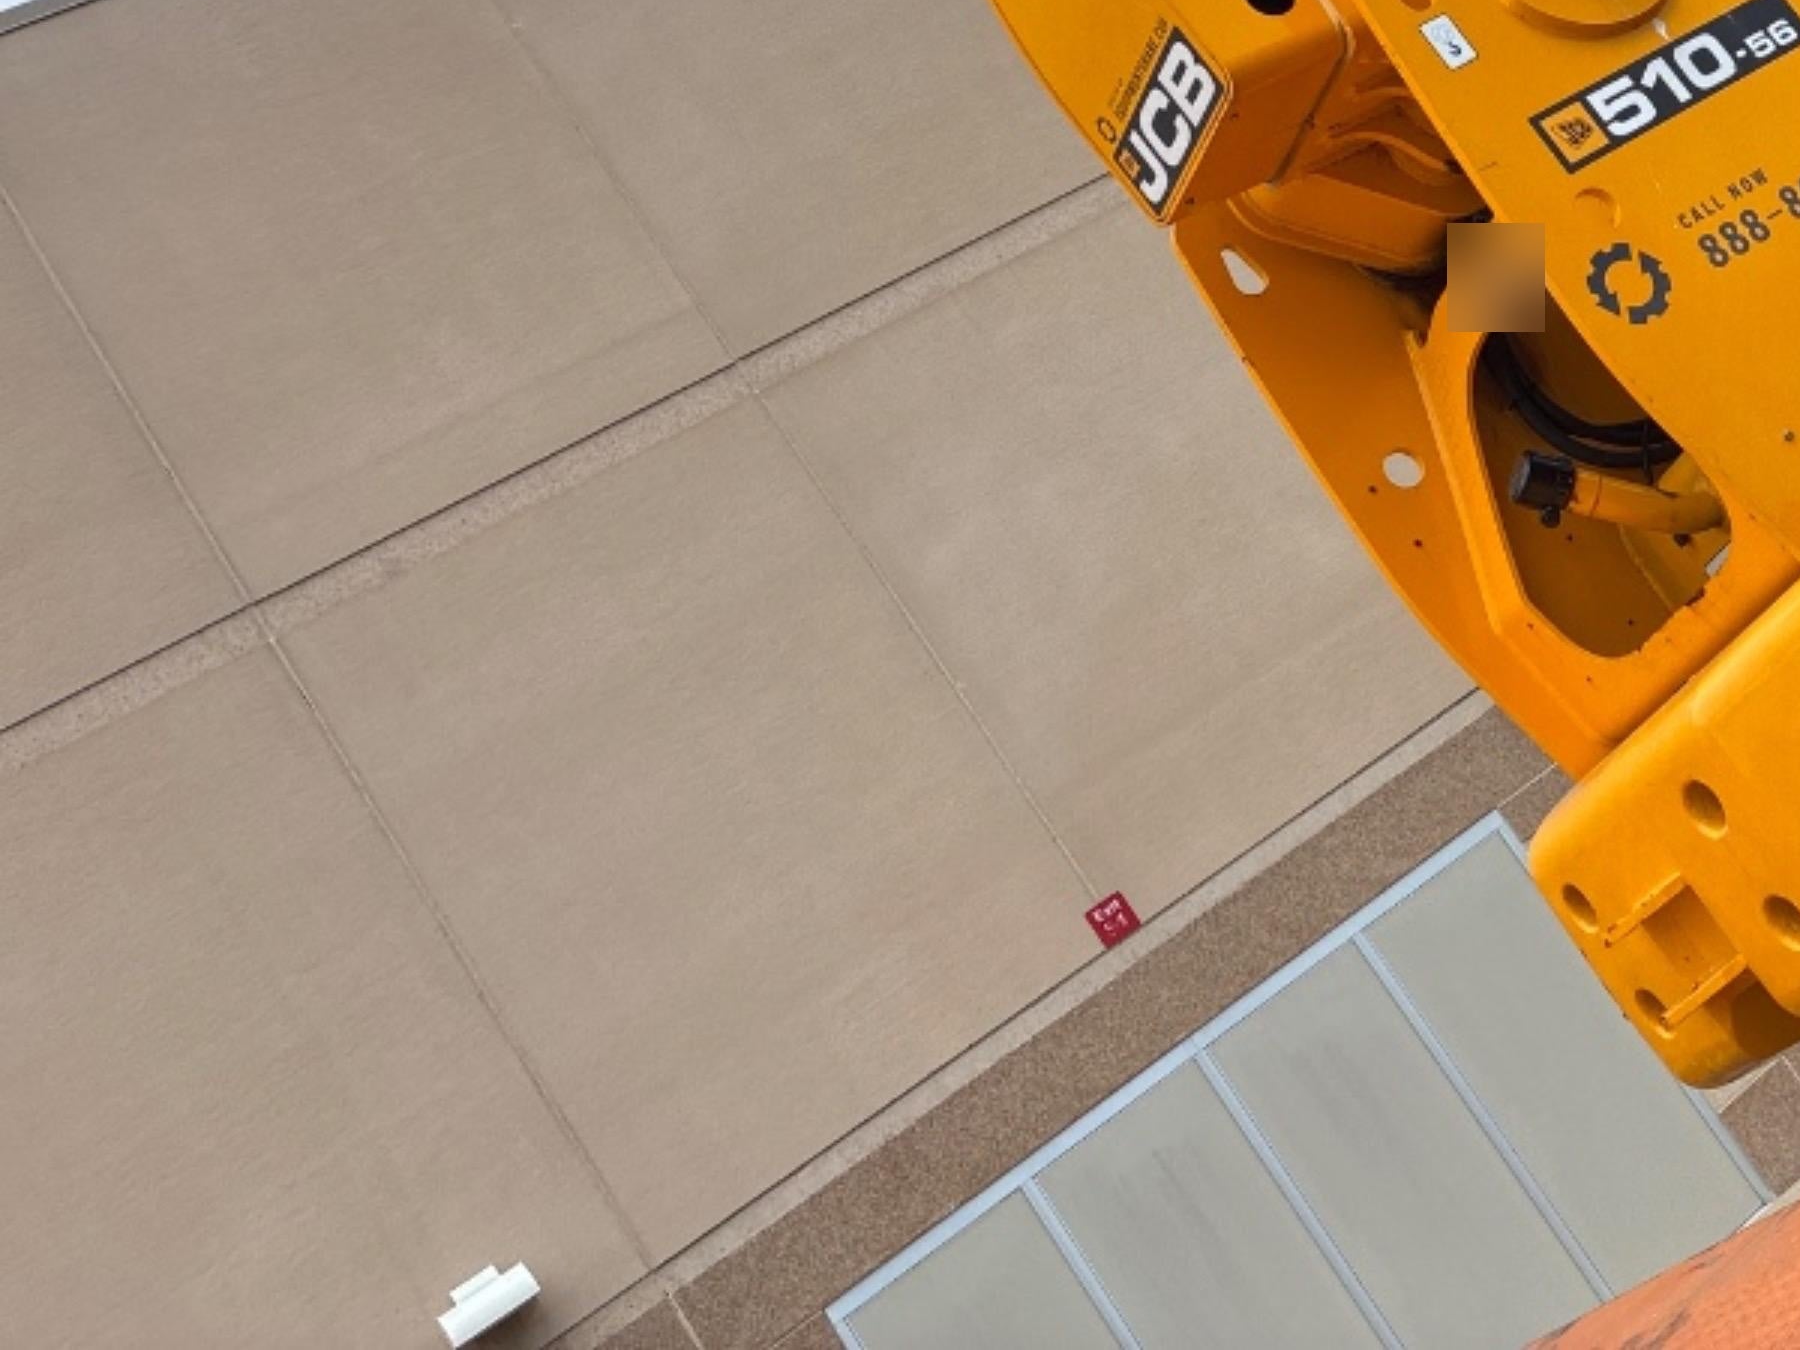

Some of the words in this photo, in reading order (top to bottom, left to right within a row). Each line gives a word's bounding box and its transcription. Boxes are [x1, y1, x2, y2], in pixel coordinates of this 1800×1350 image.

[1128, 40, 1217, 205] JCB
[1677, 195, 1726, 229] CALL
[1727, 167, 1769, 201] NOW
